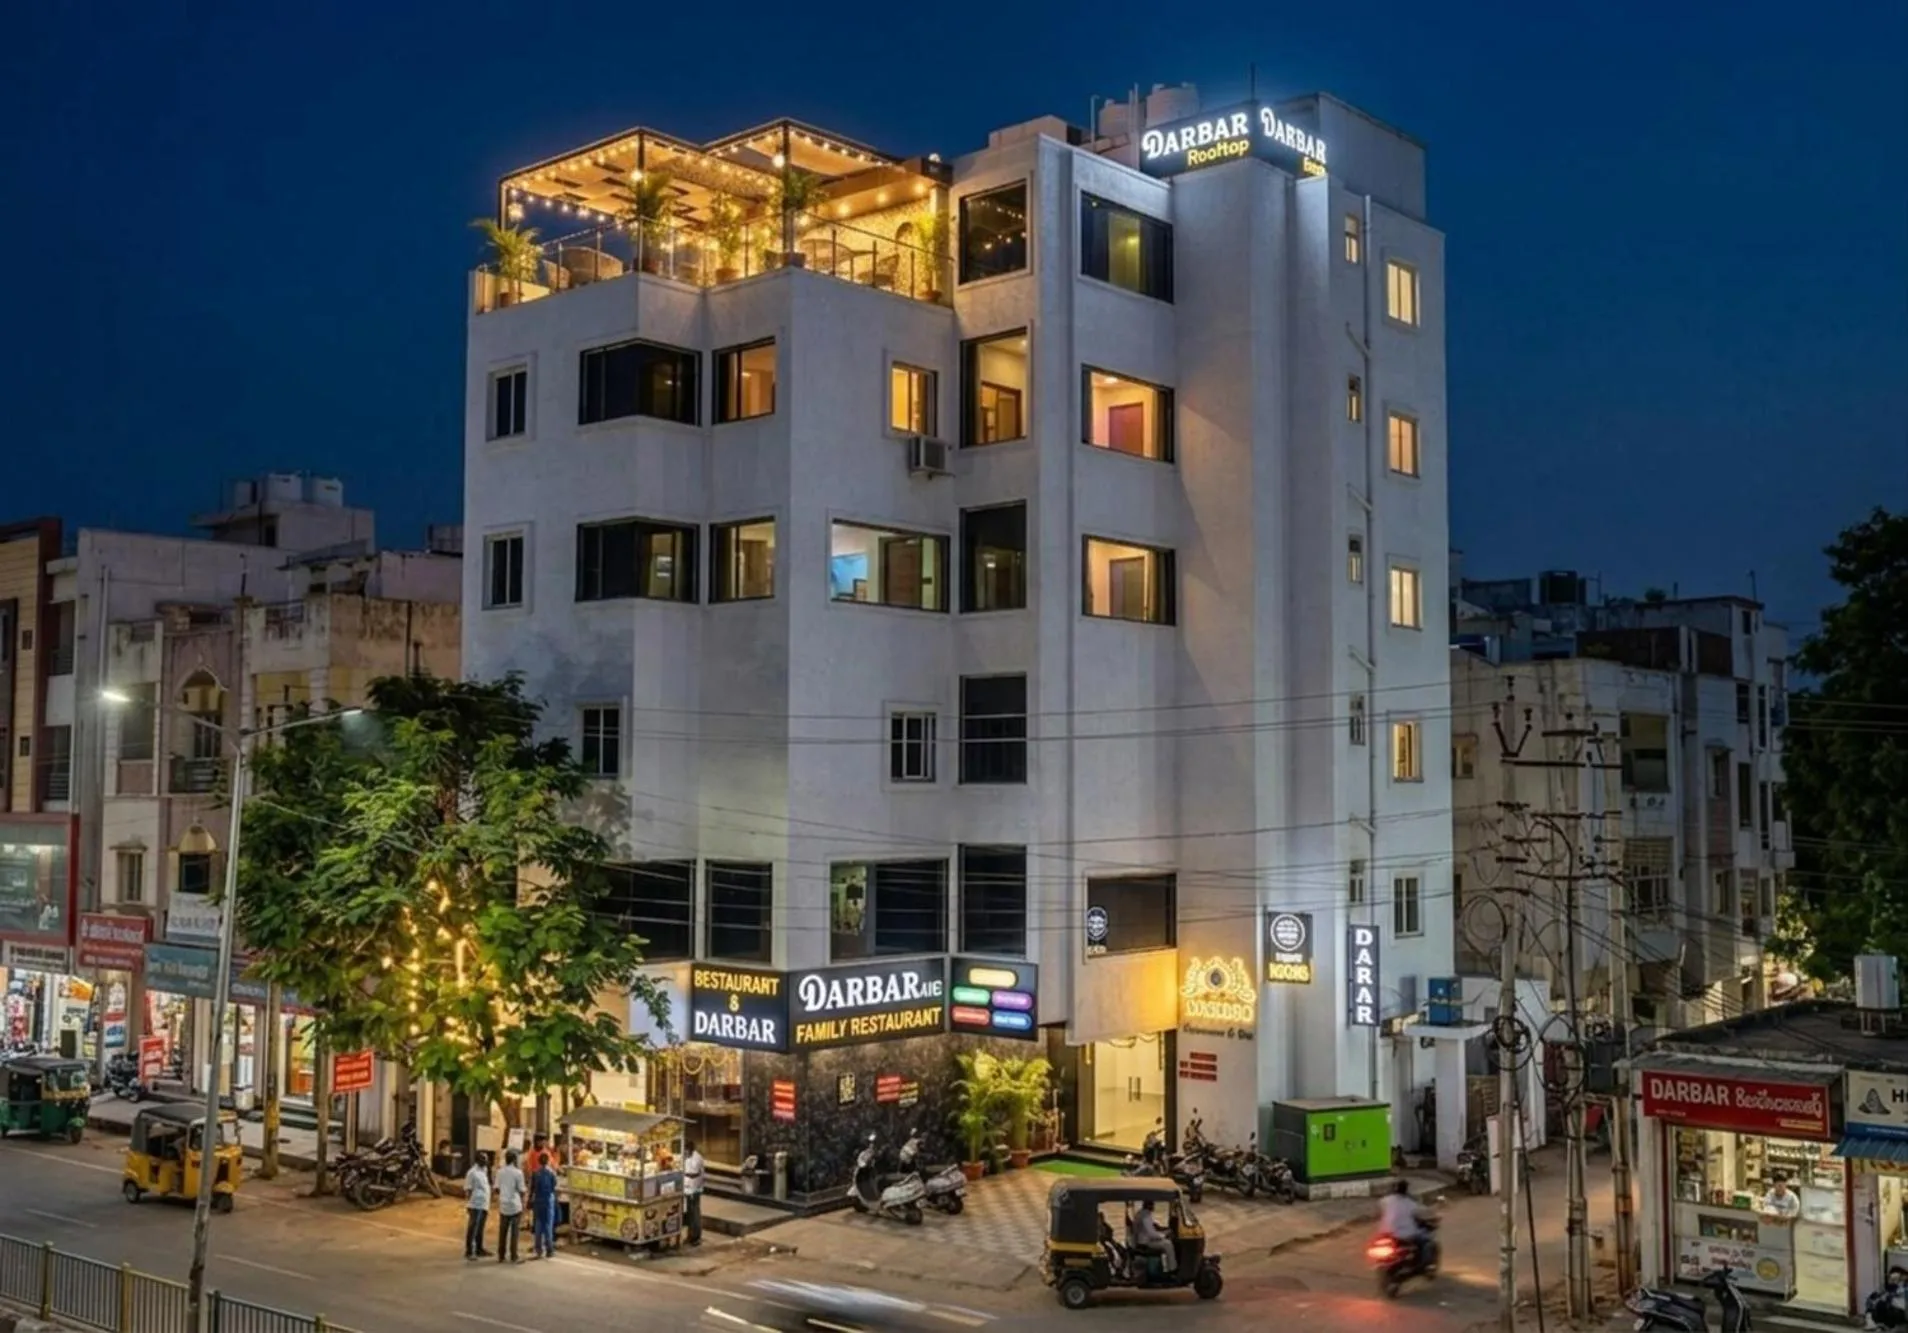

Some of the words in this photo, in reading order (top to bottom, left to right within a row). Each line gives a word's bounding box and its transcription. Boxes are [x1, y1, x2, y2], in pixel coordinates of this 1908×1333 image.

[1142, 112, 1249, 159] DARBAR
[1261, 107, 1327, 164] DARBAR
[799, 971, 921, 1012] DARBAR
[1355, 929, 1375, 1024] DARAR
[694, 1010, 776, 1044] DARBAR
[796, 1018, 848, 1044] FAMILY
[851, 1007, 942, 1036] RESTAURANT
[1650, 1078, 1730, 1106] DARBAR
